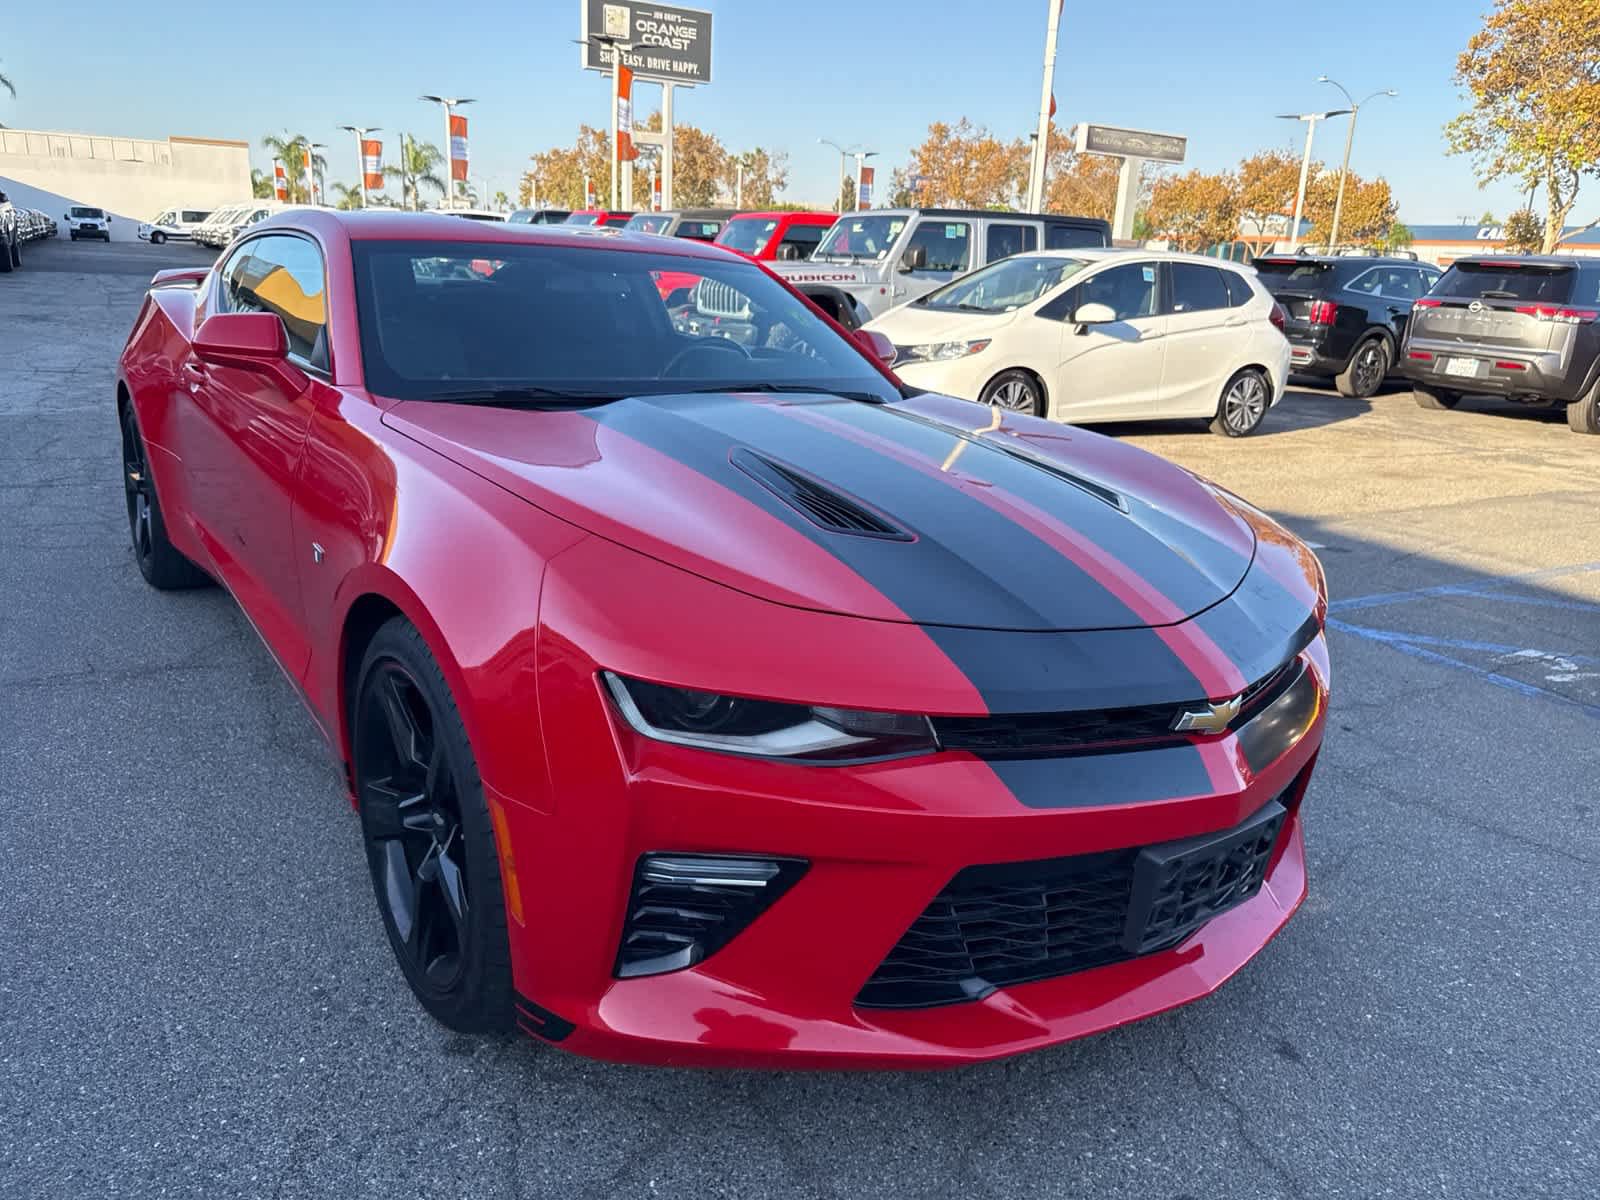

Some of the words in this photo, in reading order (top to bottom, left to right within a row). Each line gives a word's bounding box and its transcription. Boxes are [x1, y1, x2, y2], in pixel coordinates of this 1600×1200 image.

[636, 20, 697, 39] ORANGE
[642, 34, 690, 50] COAST
[600, 51, 619, 63] SHO
[623, 54, 645, 68] EASY.
[647, 57, 671, 72] DRIVE
[672, 60, 700, 75] HAPPY.
